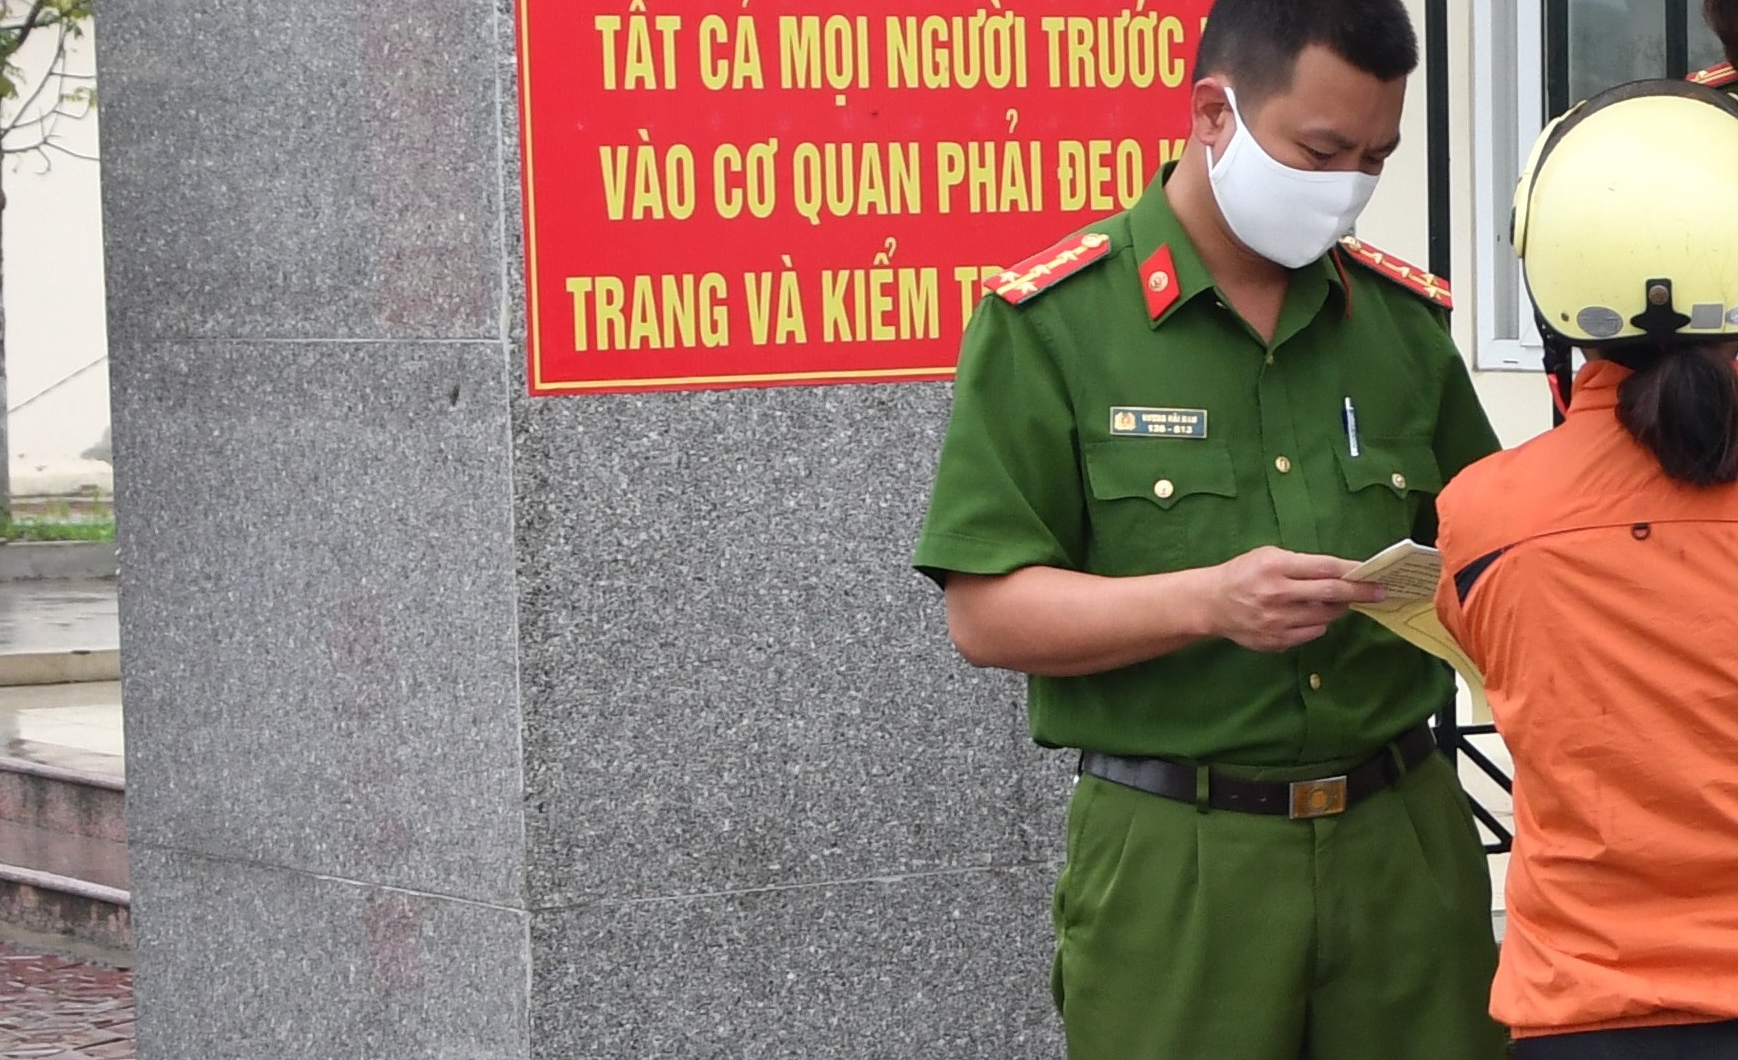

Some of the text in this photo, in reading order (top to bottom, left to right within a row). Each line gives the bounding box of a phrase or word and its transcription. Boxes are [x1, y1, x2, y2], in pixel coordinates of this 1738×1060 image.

[779, 14, 871, 106] MỌI
[599, 109, 1143, 225] VÀO CƠ QUAN PHẢI ĐEO
[565, 272, 730, 352] TRANG
[744, 255, 808, 346] VÀ
[821, 237, 941, 343] KIỂM
